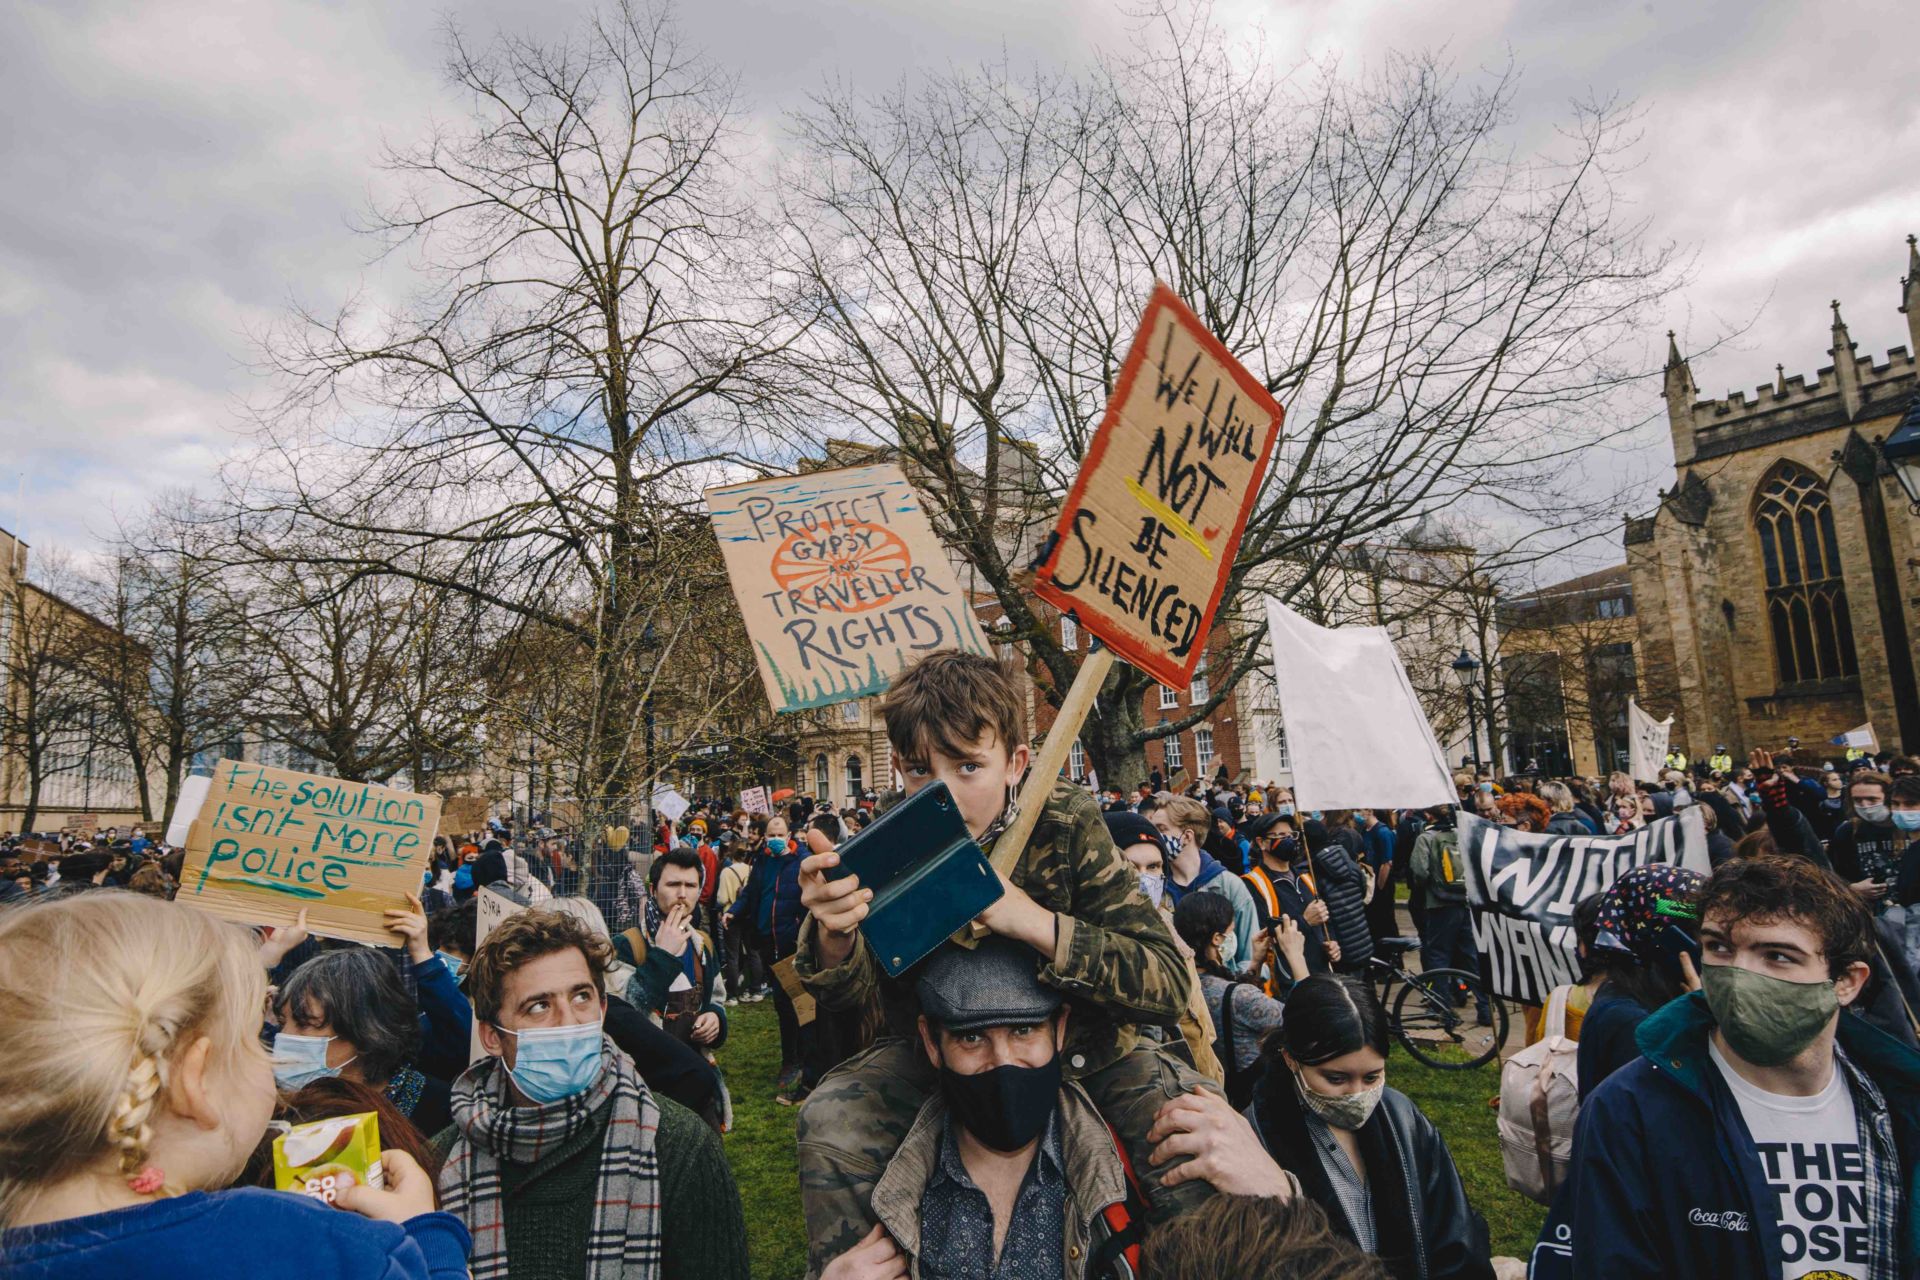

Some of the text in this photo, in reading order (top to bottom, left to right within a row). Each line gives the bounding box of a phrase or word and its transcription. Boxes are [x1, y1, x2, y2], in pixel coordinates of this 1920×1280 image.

[1138, 422, 1227, 525] NOT
[738, 492, 890, 543] PROTECT
[792, 530, 873, 560] GYPSY
[829, 560, 861, 575] AND
[1130, 516, 1176, 571] BE
[762, 566, 950, 618] TRAVELLER
[1050, 508, 1203, 657] SILENCED
[783, 604, 944, 670] RIGHTS
[291, 781, 424, 821] solution
[311, 822, 420, 861] More
[1481, 818, 1677, 916] WITH
[1754, 1142, 1865, 1181] THE
[308, 1188, 337, 1206] P
